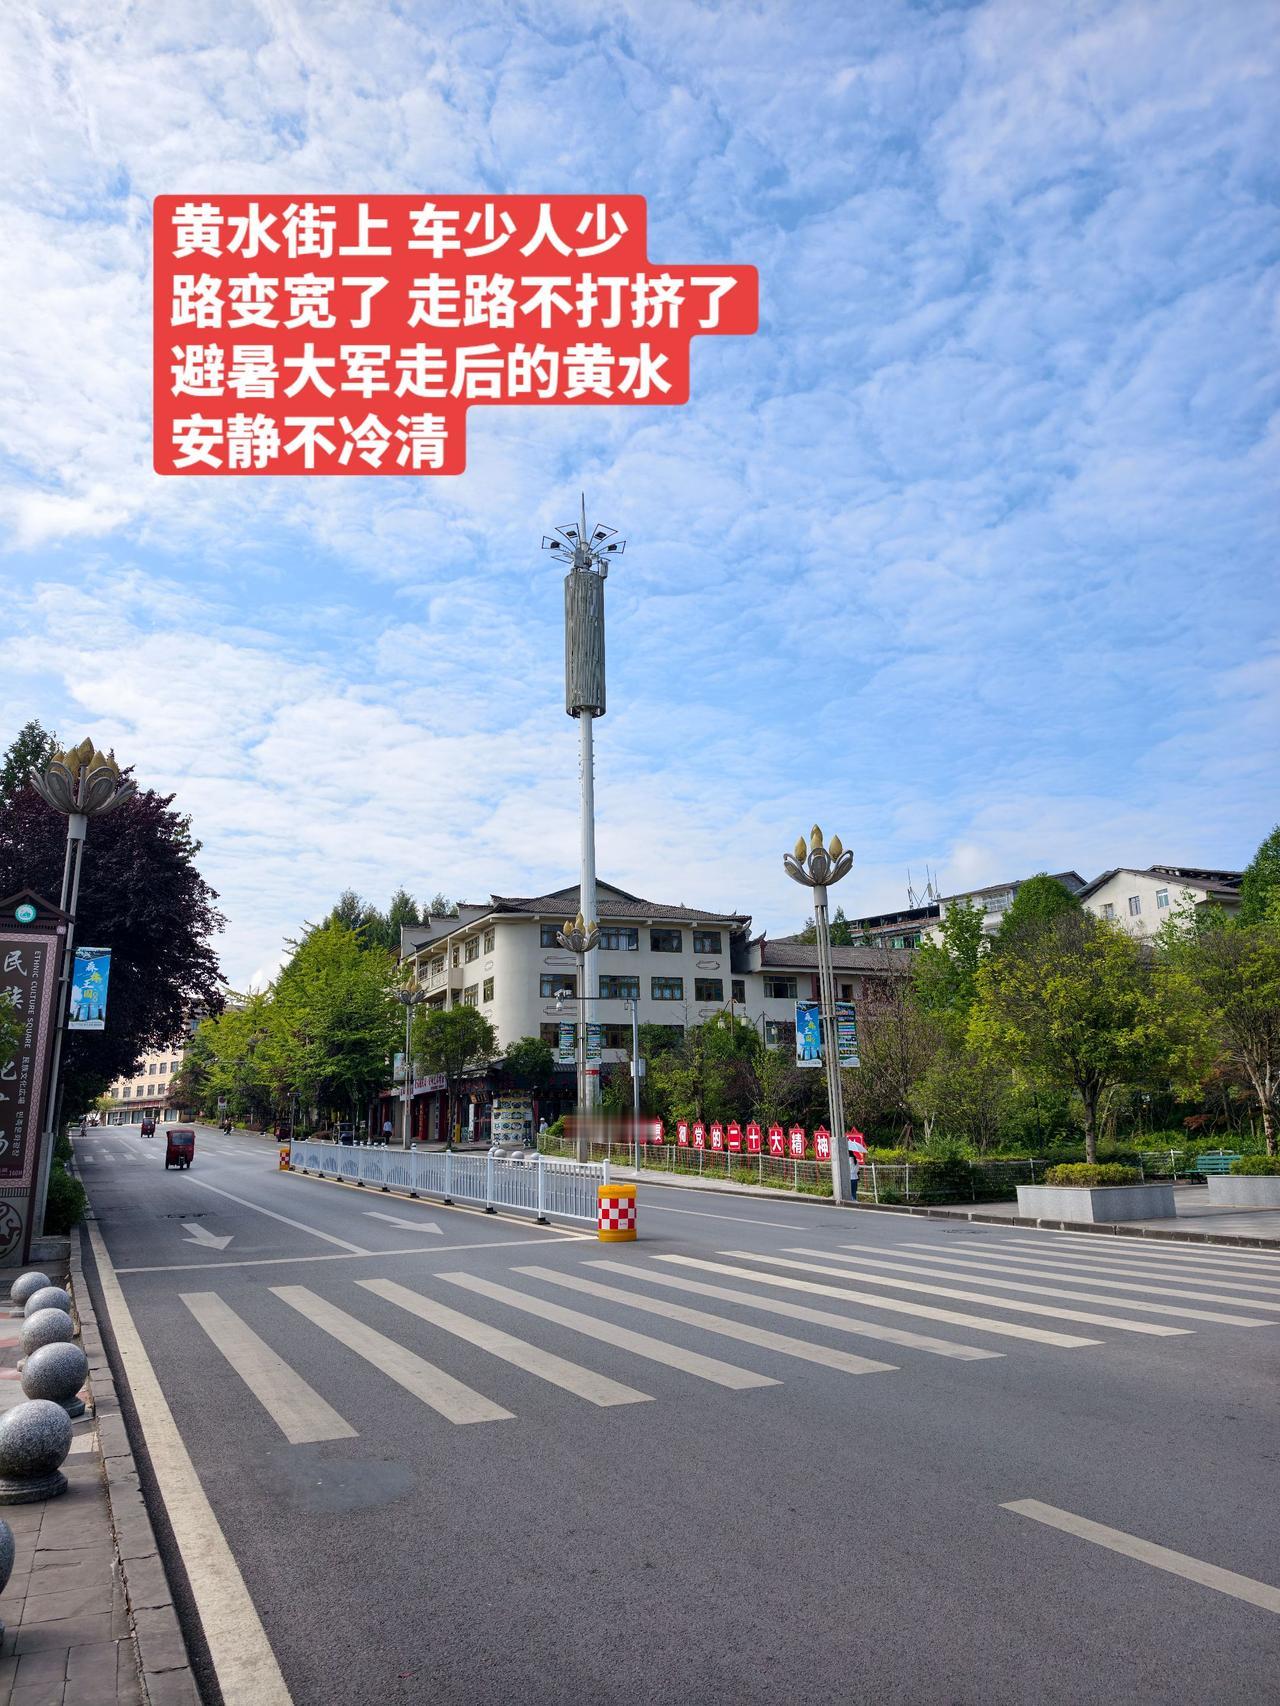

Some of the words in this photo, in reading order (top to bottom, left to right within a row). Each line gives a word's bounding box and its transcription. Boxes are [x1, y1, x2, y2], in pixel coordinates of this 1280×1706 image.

[31, 950, 41, 978] ETHNIC
[27, 981, 38, 1015] CULTURE
[24, 1017, 34, 1049] SQUARE
